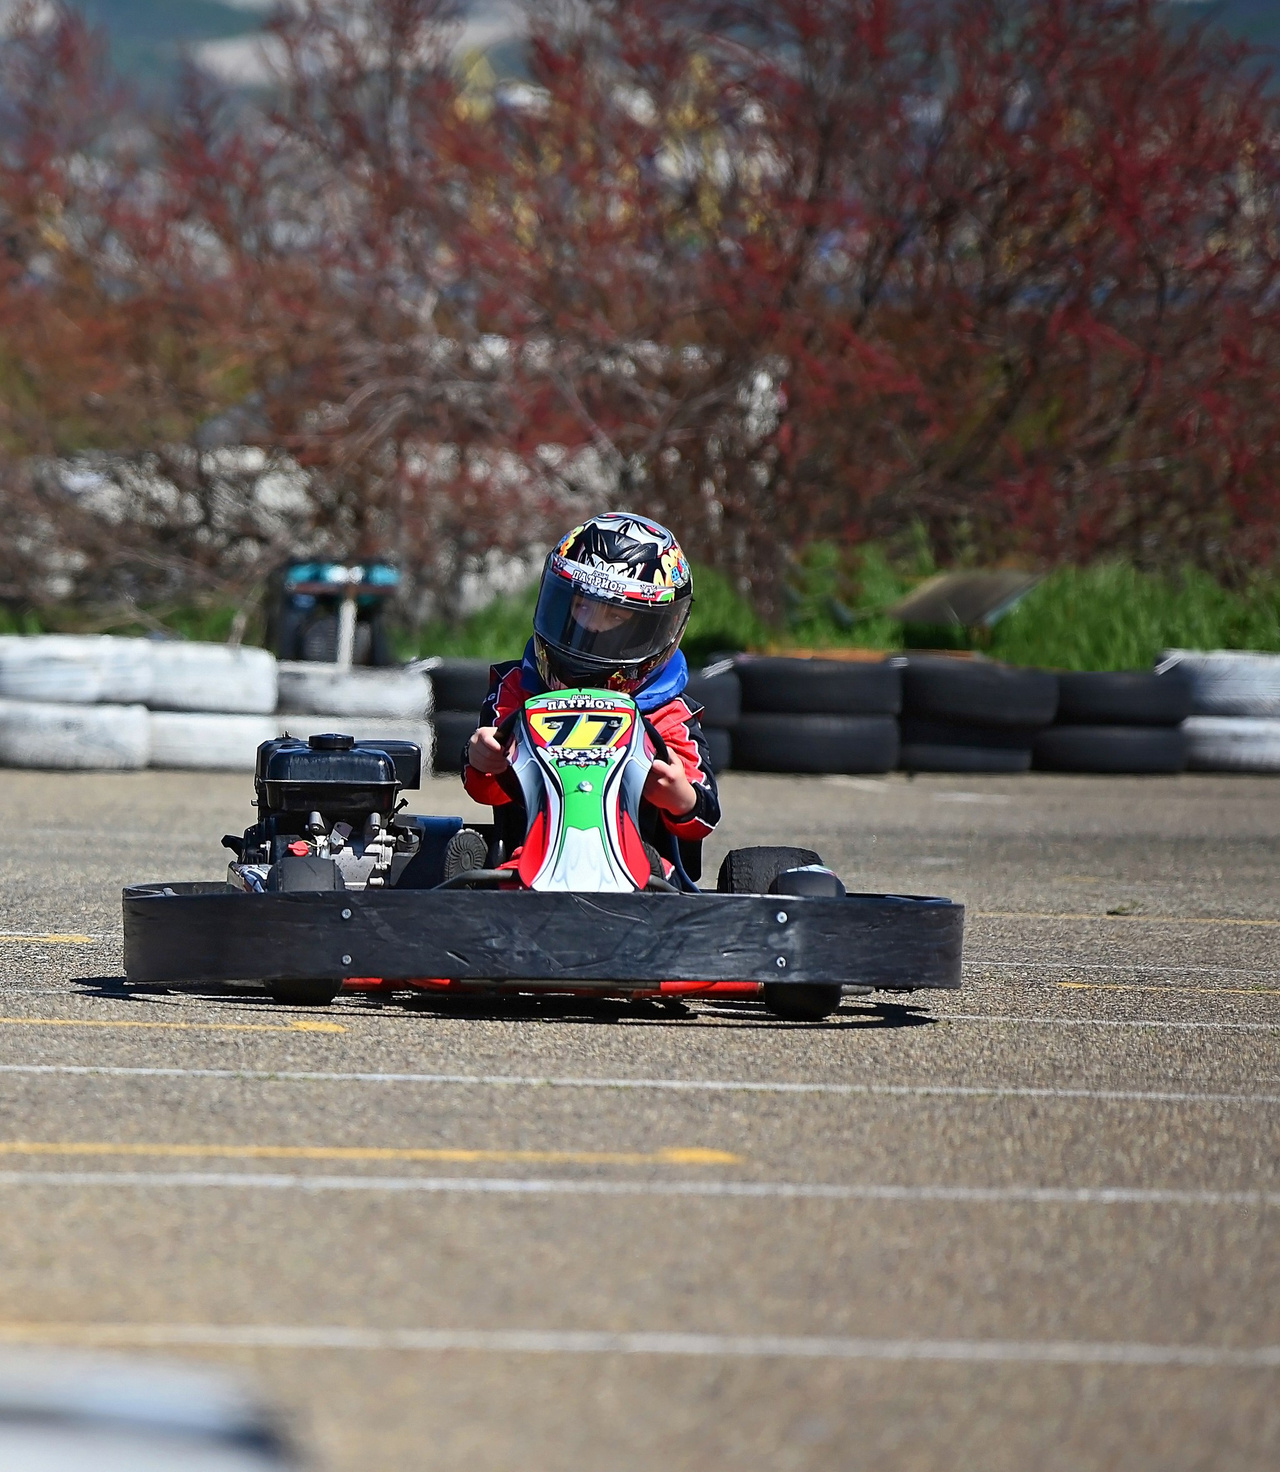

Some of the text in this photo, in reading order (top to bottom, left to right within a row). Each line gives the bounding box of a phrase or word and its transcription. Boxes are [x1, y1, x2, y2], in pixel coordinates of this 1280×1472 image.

[572, 569, 627, 593] ПАТРИОТ
[547, 699, 615, 710] ПАТРИОТ
[542, 713, 626, 747] 77
